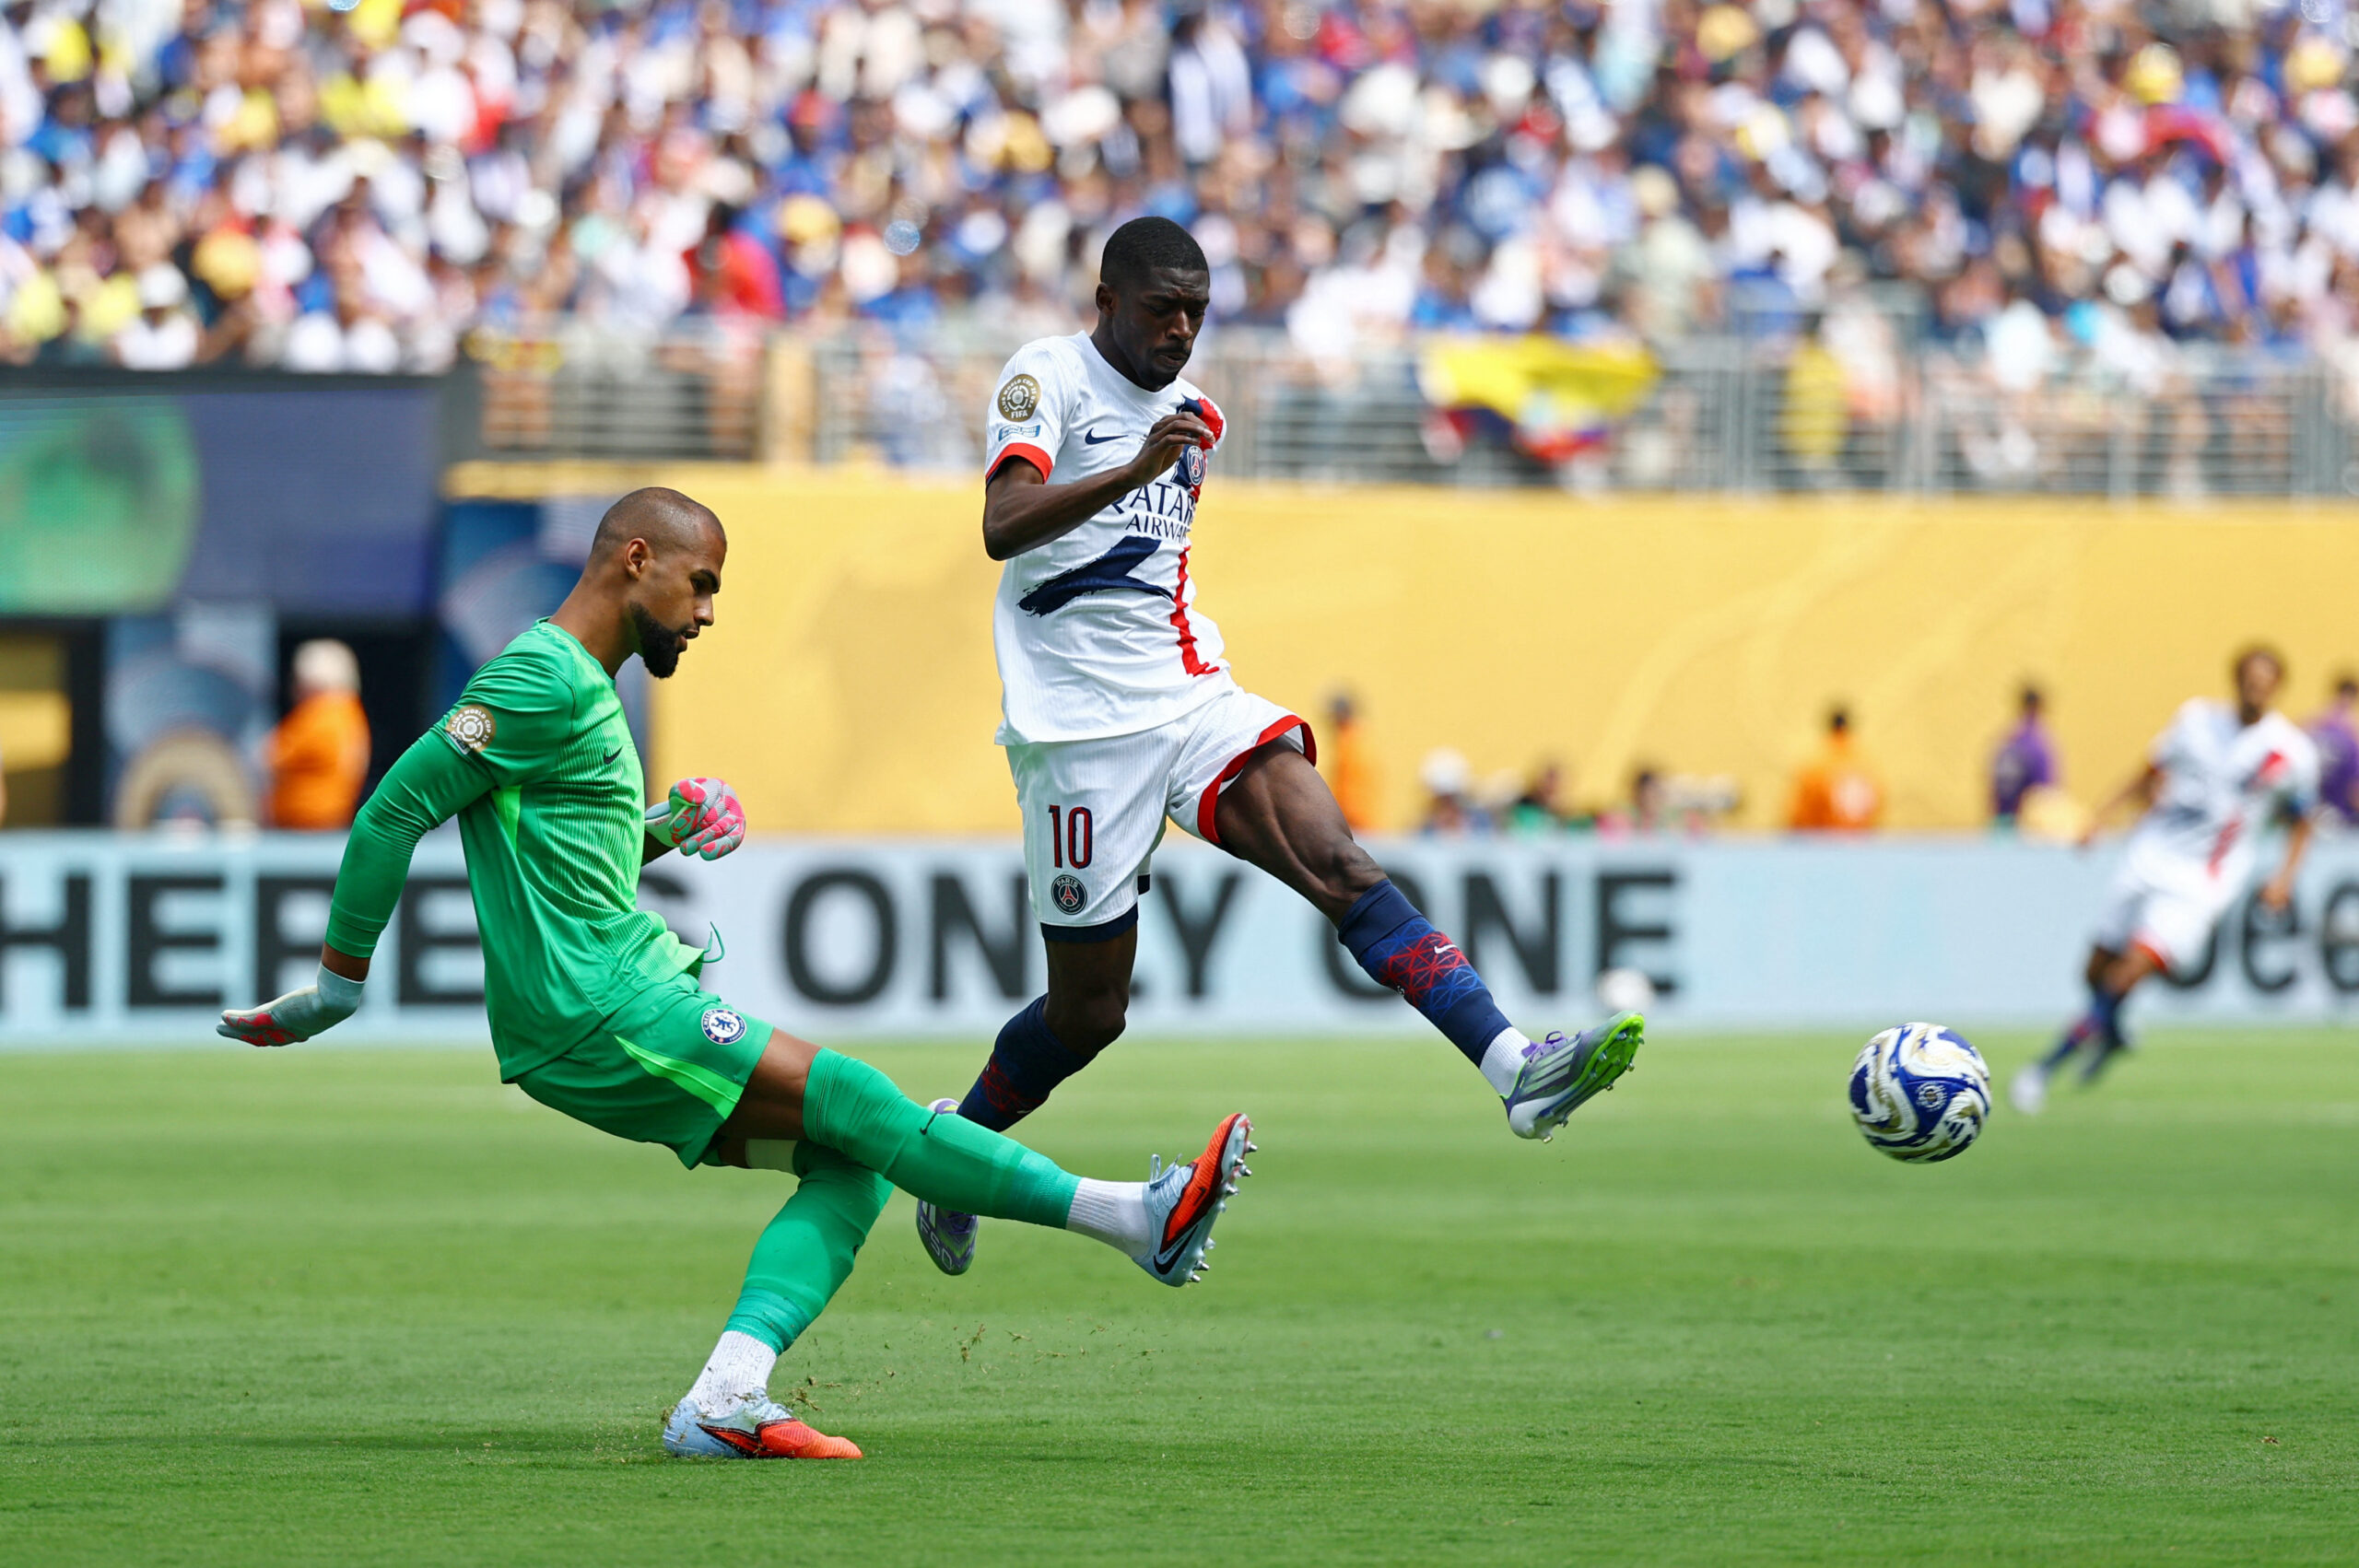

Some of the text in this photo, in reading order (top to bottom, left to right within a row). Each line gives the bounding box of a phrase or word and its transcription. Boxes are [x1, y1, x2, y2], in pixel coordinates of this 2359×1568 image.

[1011, 409, 1028, 419] FIFA
[464, 709, 486, 719] WORLD
[1049, 804, 1092, 869] 10
[1056, 878, 1079, 888] PARIS
